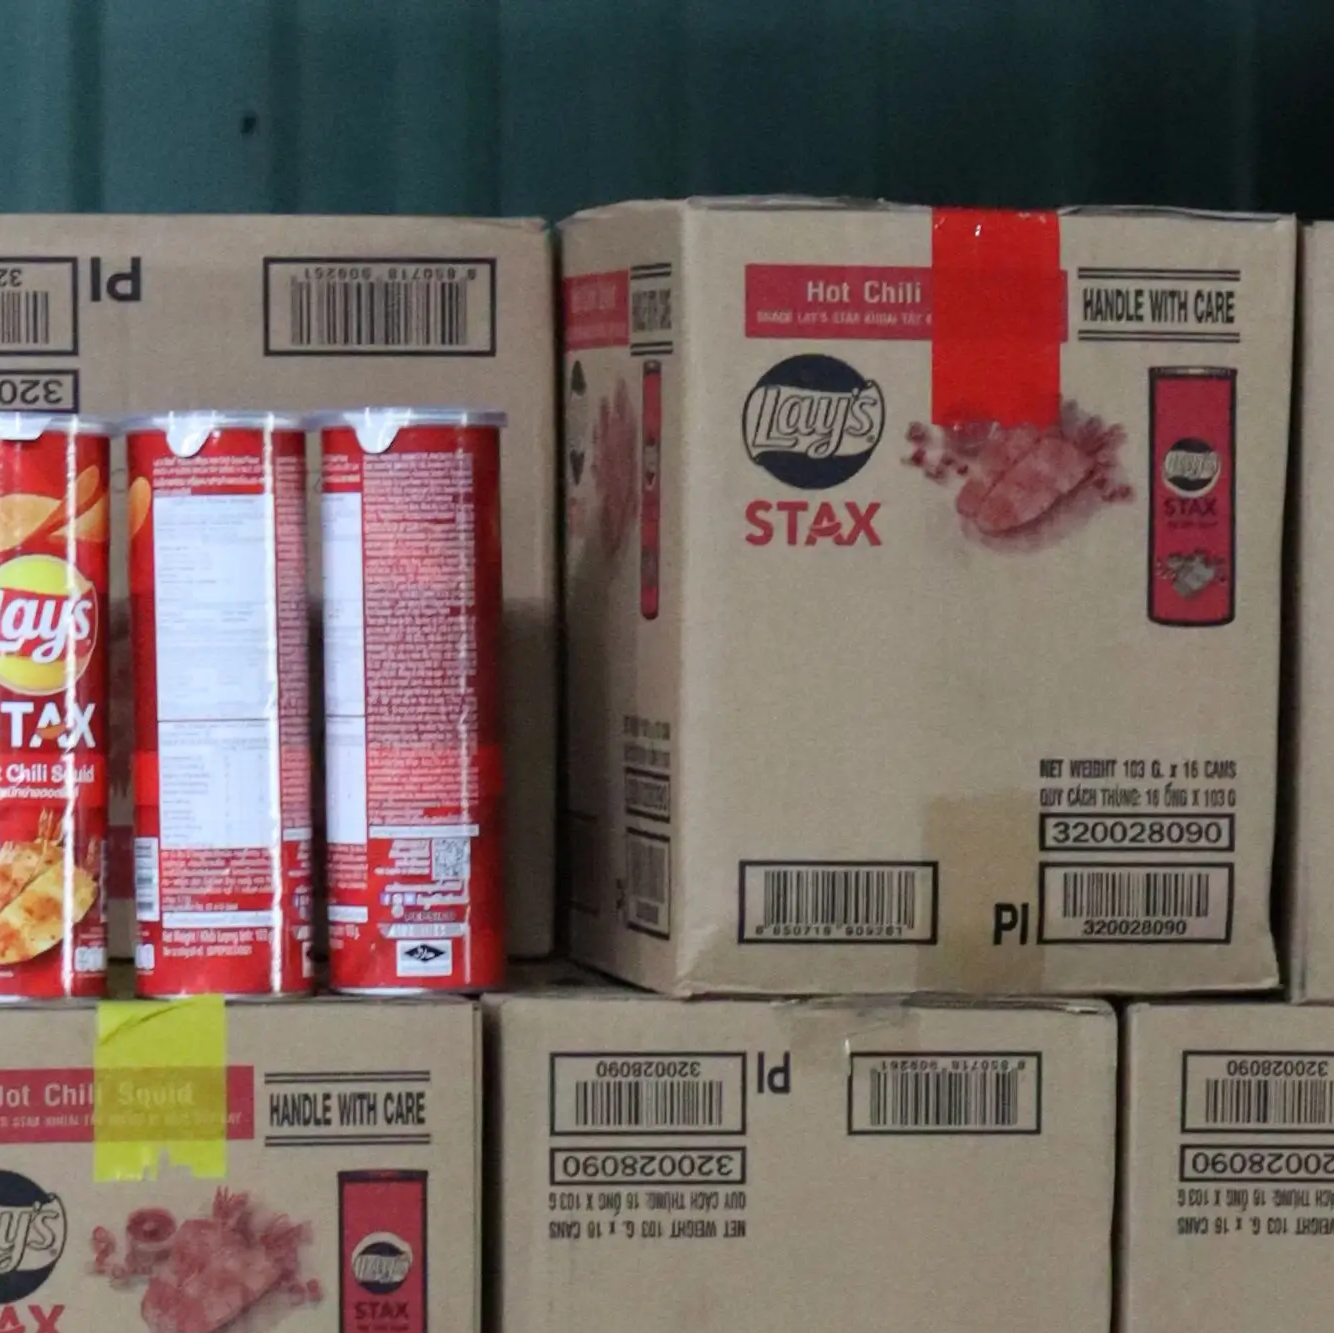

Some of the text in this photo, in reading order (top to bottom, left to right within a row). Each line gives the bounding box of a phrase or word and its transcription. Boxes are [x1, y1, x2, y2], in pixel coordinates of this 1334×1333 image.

[808, 281, 920, 303] Hot Chili
[1084, 289, 1234, 323] HANDLE WITH CARE
[746, 500, 879, 545] STAX
[6, 764, 47, 782] Chili
[1053, 821, 1222, 843] 320028090
[563, 1155, 733, 1177] 320028090
